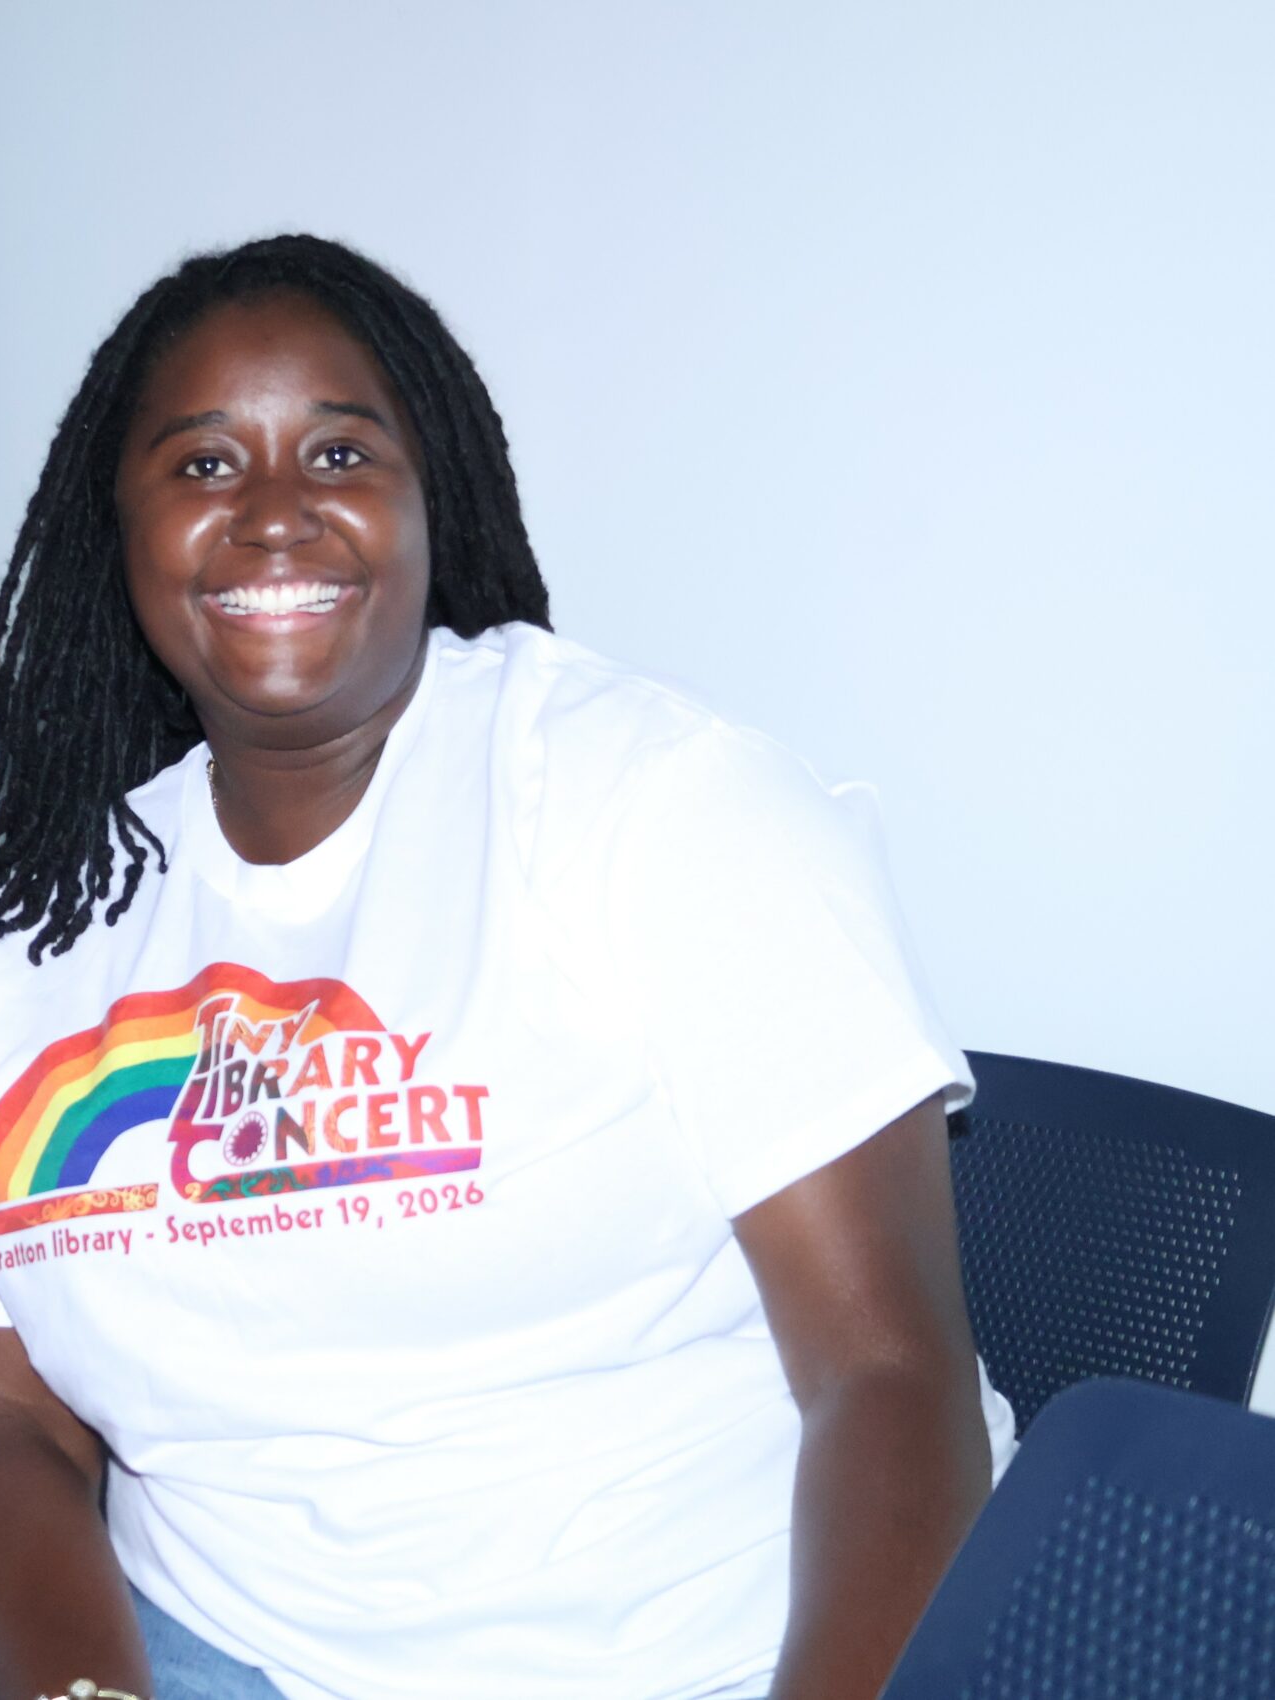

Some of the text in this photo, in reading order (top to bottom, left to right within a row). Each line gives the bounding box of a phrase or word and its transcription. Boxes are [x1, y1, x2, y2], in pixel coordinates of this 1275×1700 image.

[196, 997, 317, 1075] TINY
[168, 1031, 433, 1142] LIBRARY
[170, 1084, 490, 1198] CONCERT
[52, 1228, 132, 1256] library
[166, 1203, 324, 1247] September
[336, 1196, 383, 1229] 19,
[396, 1181, 485, 1219] 2026
